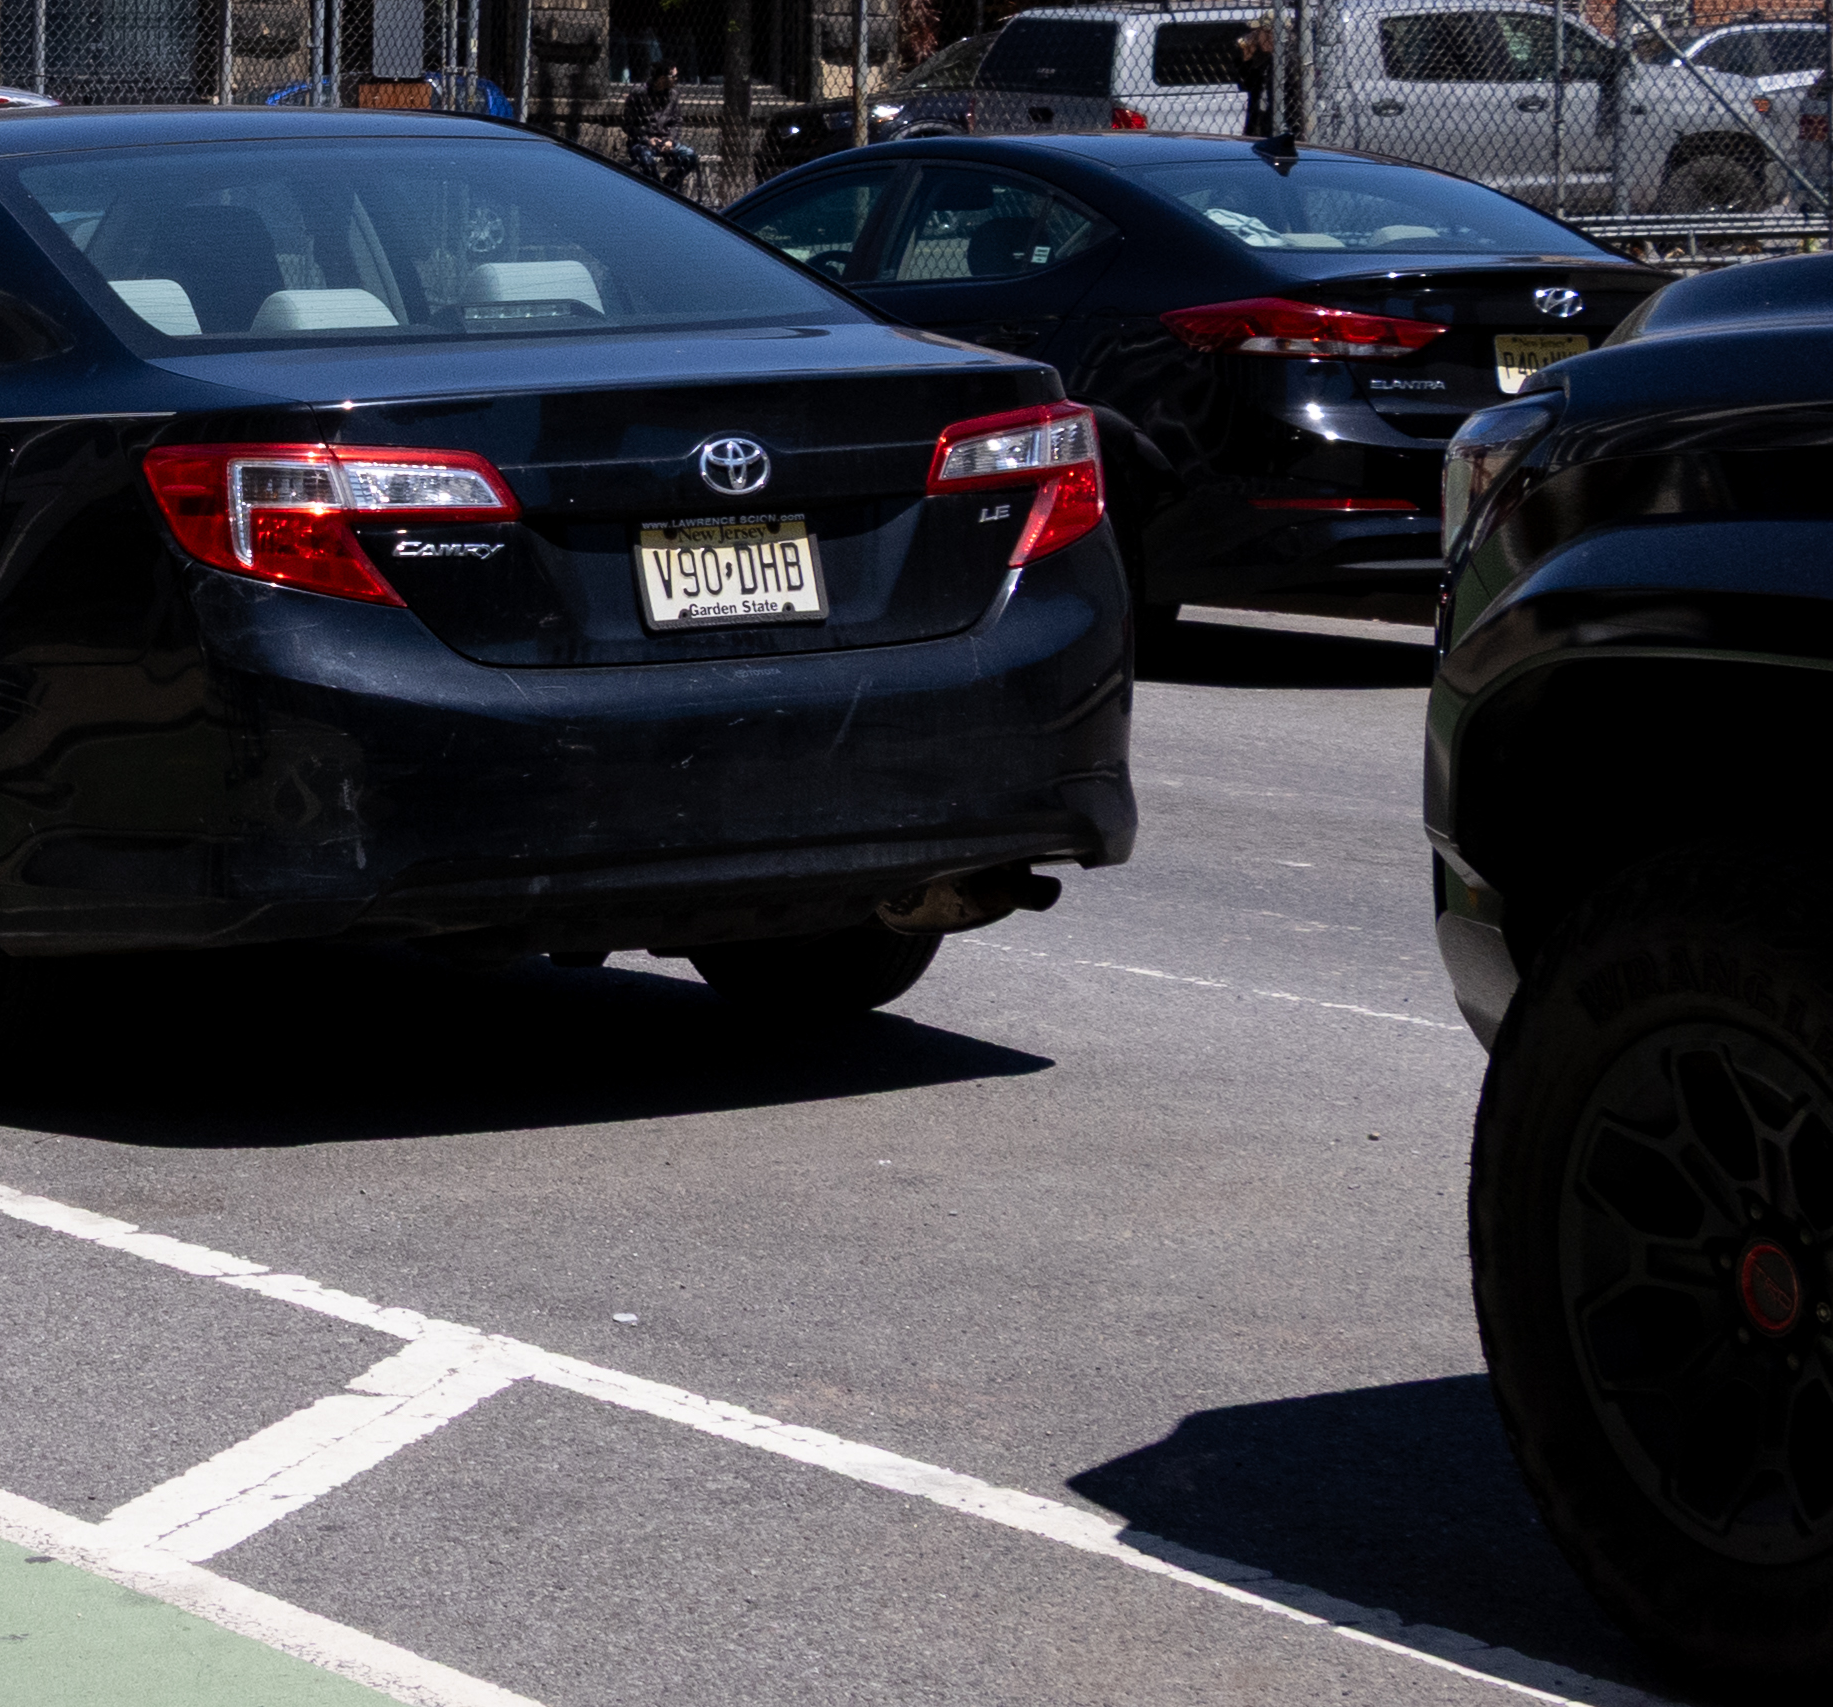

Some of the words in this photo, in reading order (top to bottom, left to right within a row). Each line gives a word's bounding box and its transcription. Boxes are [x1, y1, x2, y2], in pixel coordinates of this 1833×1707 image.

[1370, 379, 1445, 390] ELANTRA
[979, 504, 1011, 523] LE
[678, 528, 715, 543] New
[719, 524, 767, 544] Jersey
[392, 541, 505, 560] CAMRY
[689, 602, 737, 616] Garden
[742, 600, 778, 613] State
